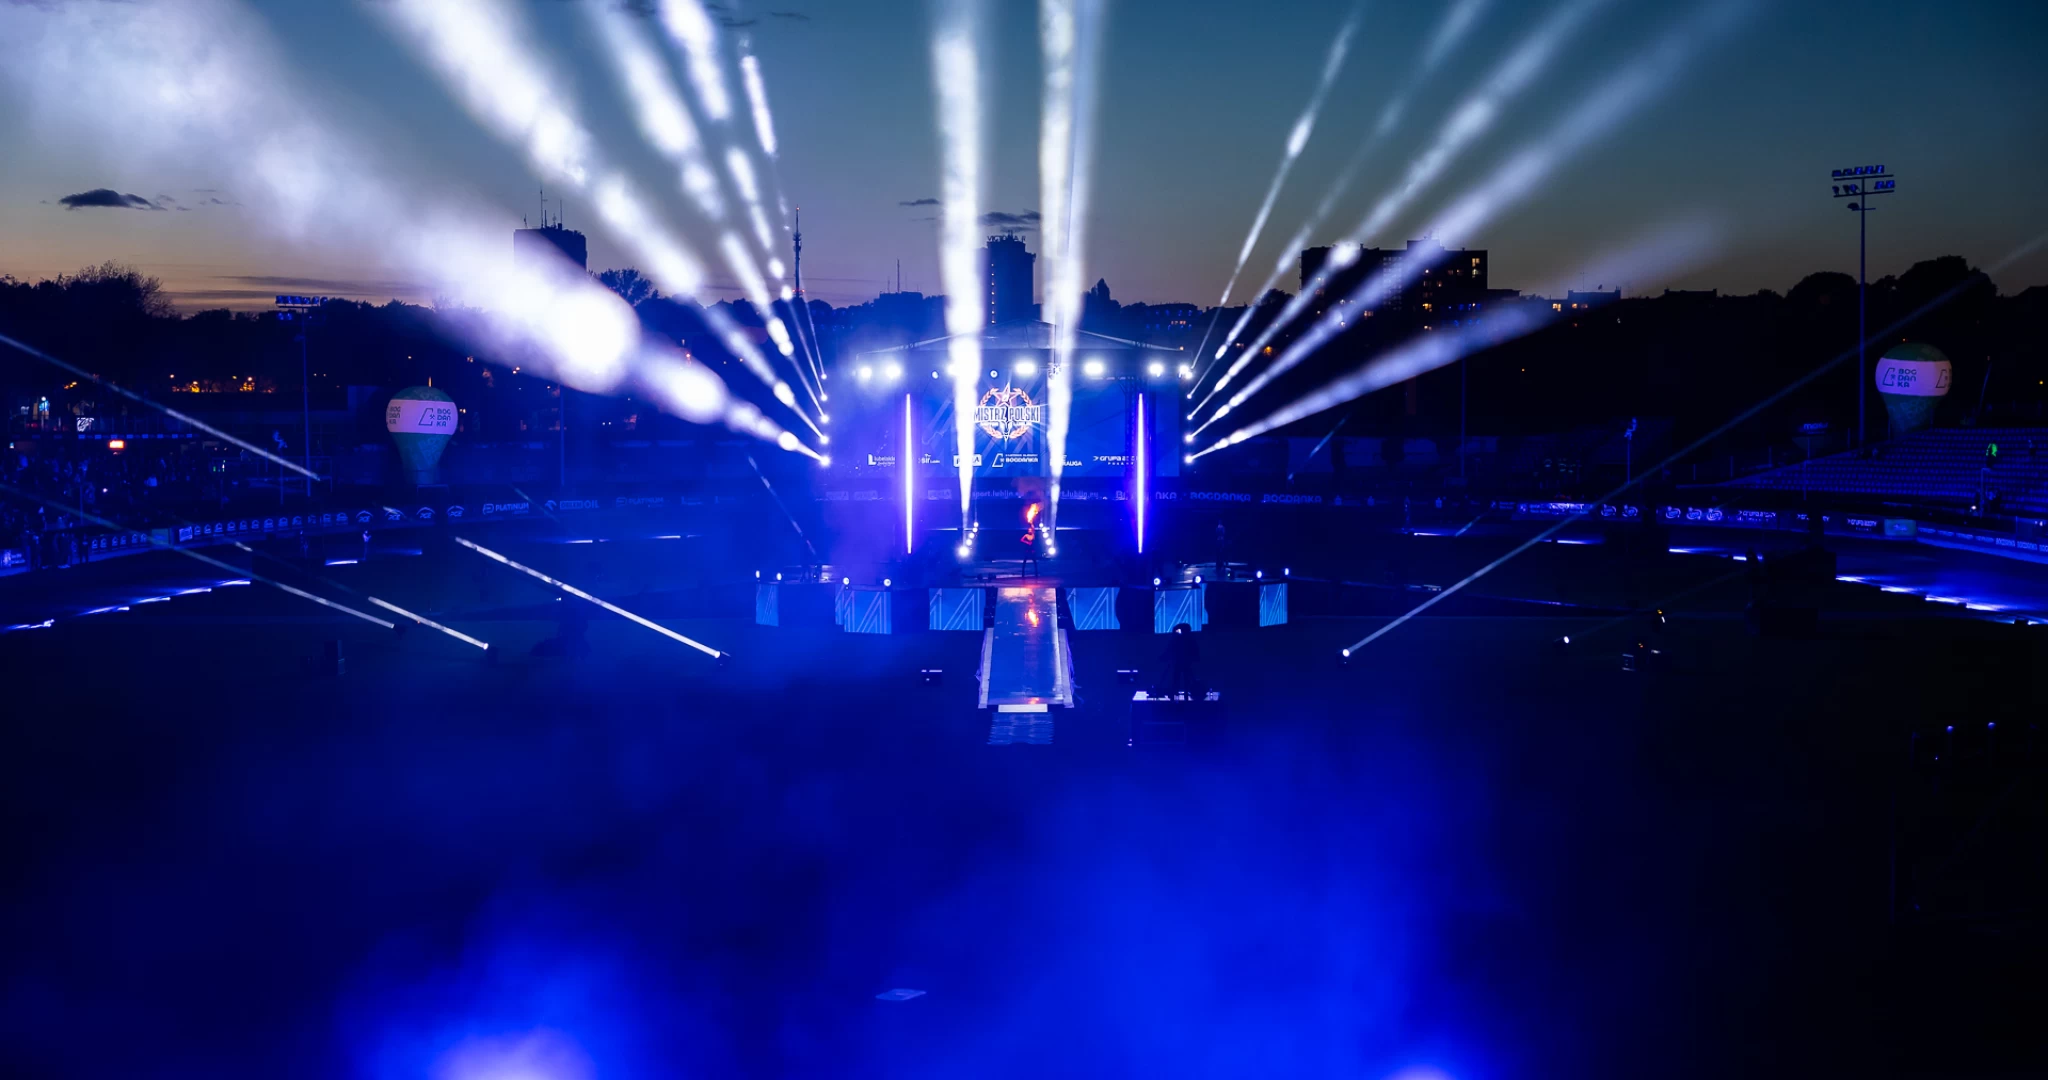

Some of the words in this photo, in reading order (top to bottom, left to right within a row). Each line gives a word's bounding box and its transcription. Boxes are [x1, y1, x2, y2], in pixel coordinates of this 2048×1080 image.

[974, 406, 1006, 422] MISTRZ
[1009, 406, 1040, 422] POLSKI
[1189, 491, 1252, 502] BOGDANKA
[1262, 493, 1323, 504] BOGDANKA
[495, 503, 529, 512] PLATINUM
[583, 500, 600, 509] OIL
